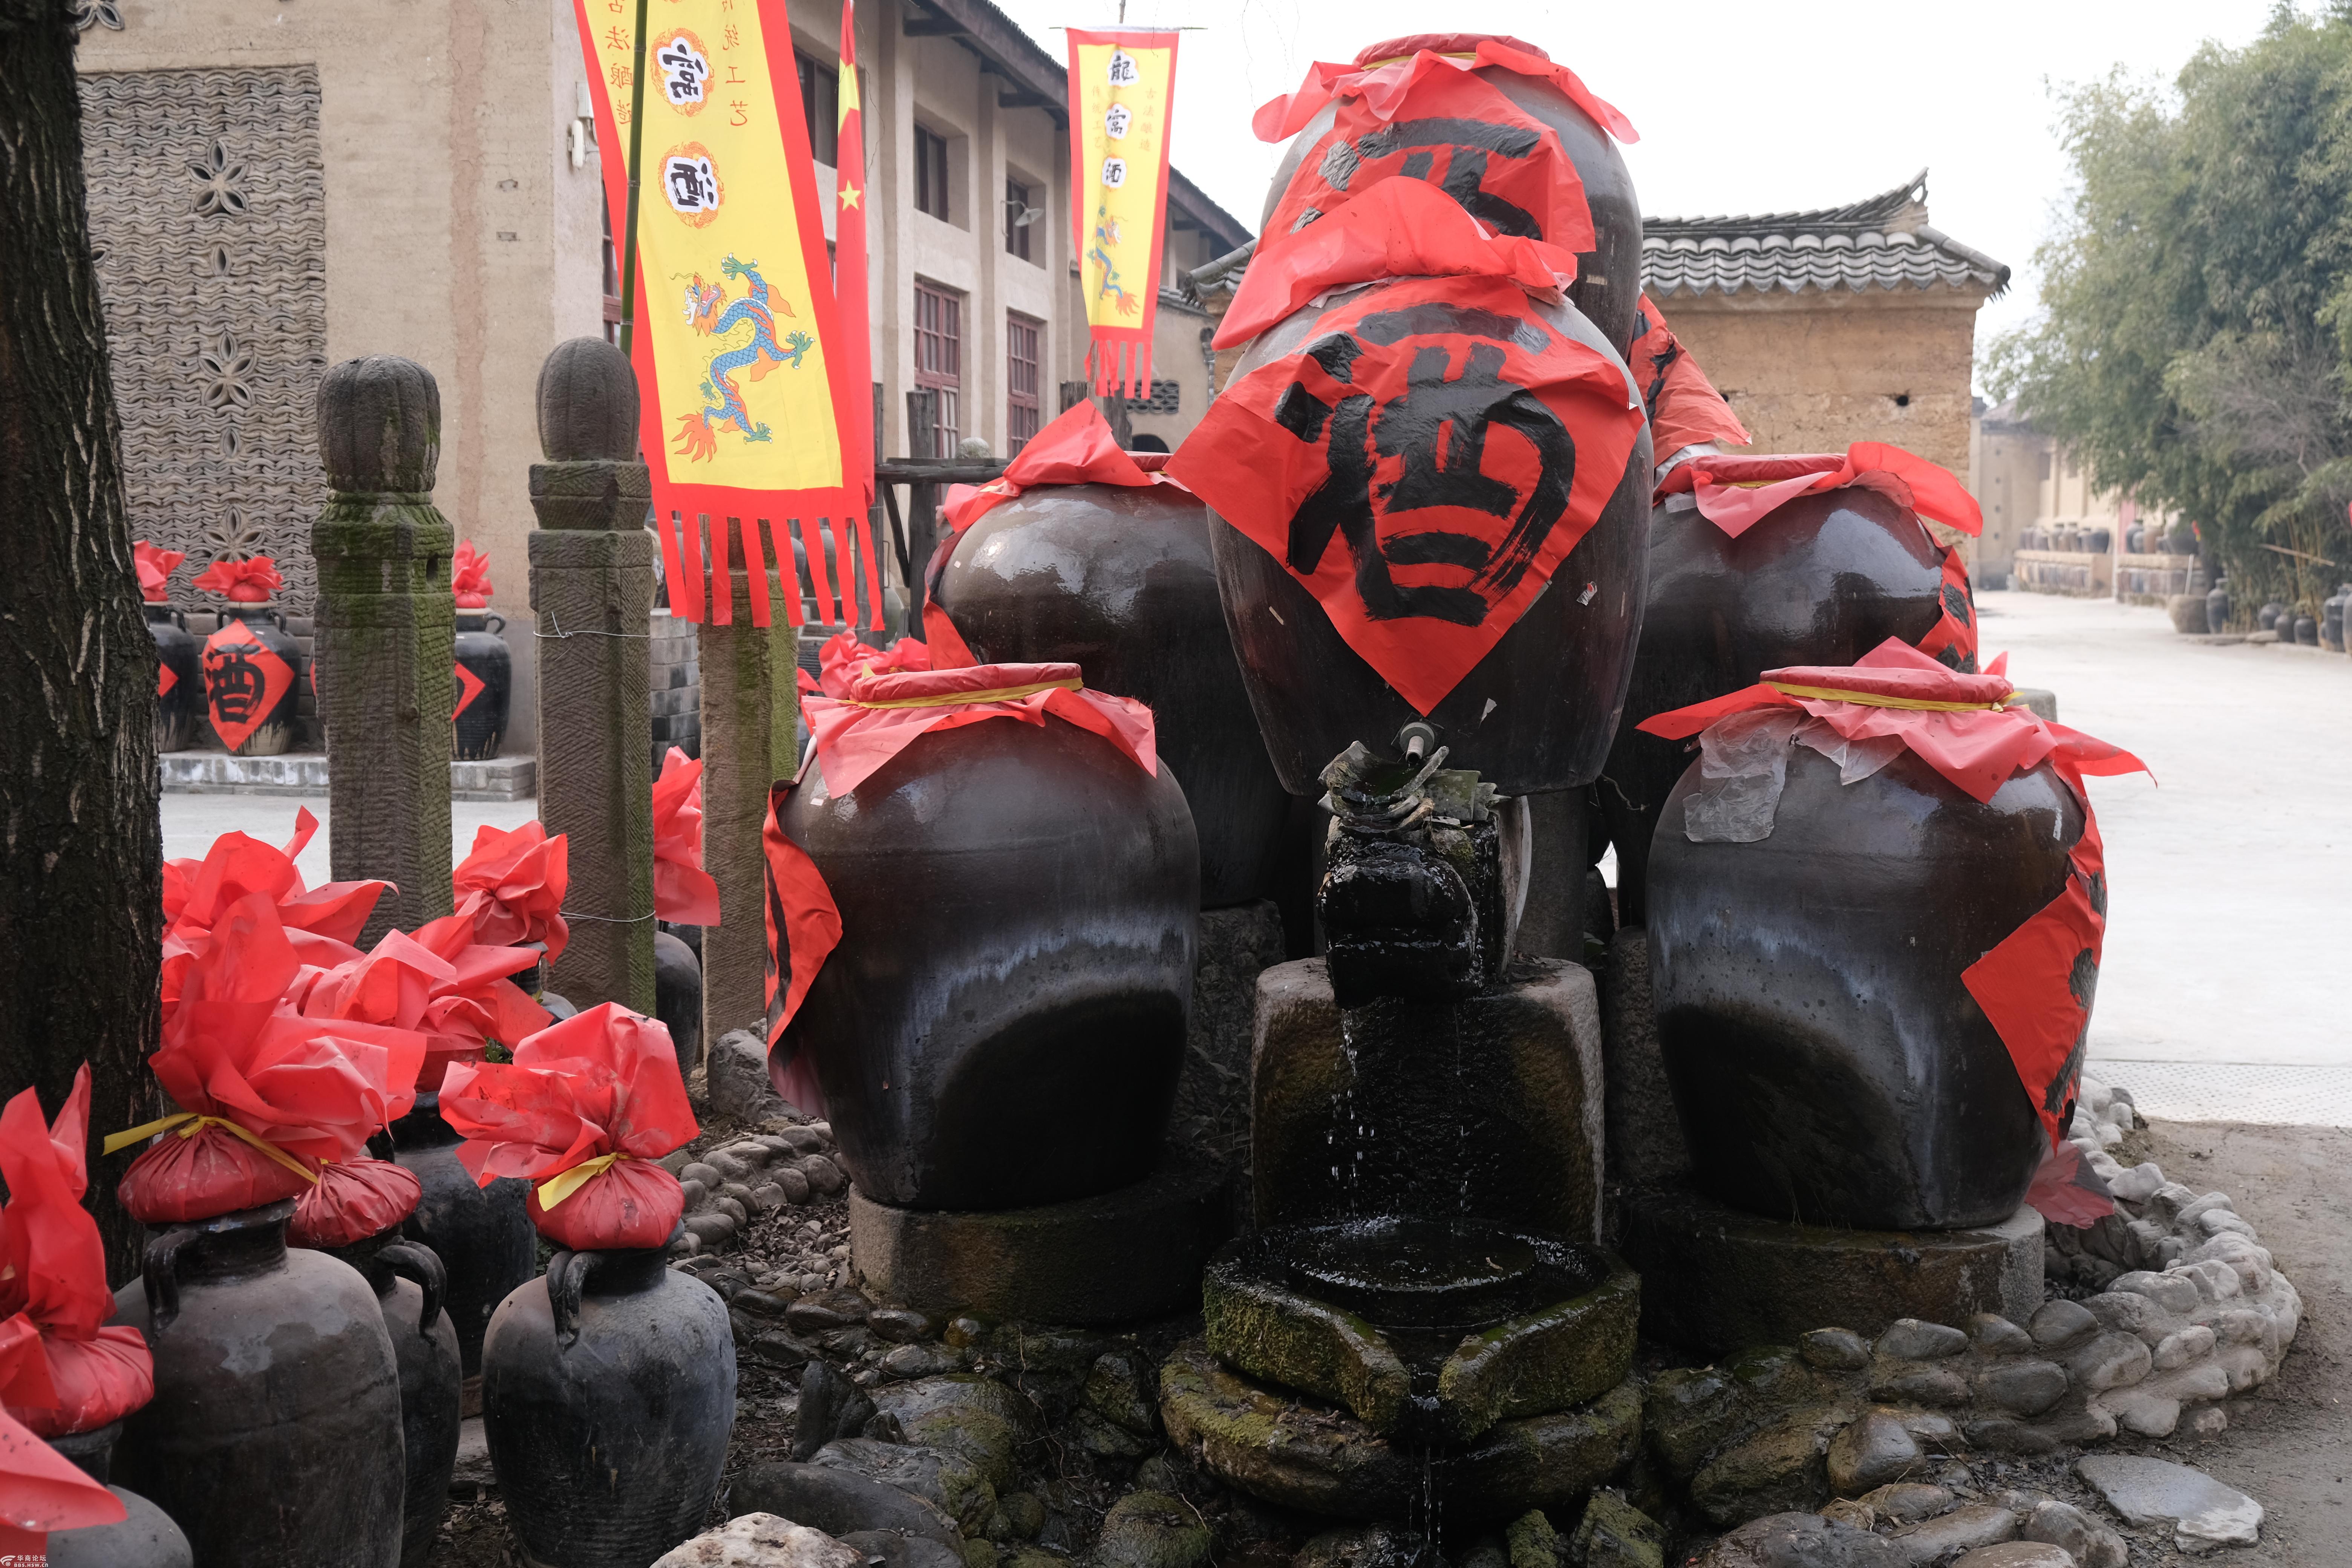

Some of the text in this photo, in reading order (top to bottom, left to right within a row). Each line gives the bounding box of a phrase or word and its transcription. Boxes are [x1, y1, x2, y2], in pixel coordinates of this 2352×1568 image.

[1092, 85, 1102, 148] 传统工艺
[1139, 87, 1156, 152] 古法酿造
[1275, 302, 1576, 628] 酒
[205, 643, 265, 724] 酒
